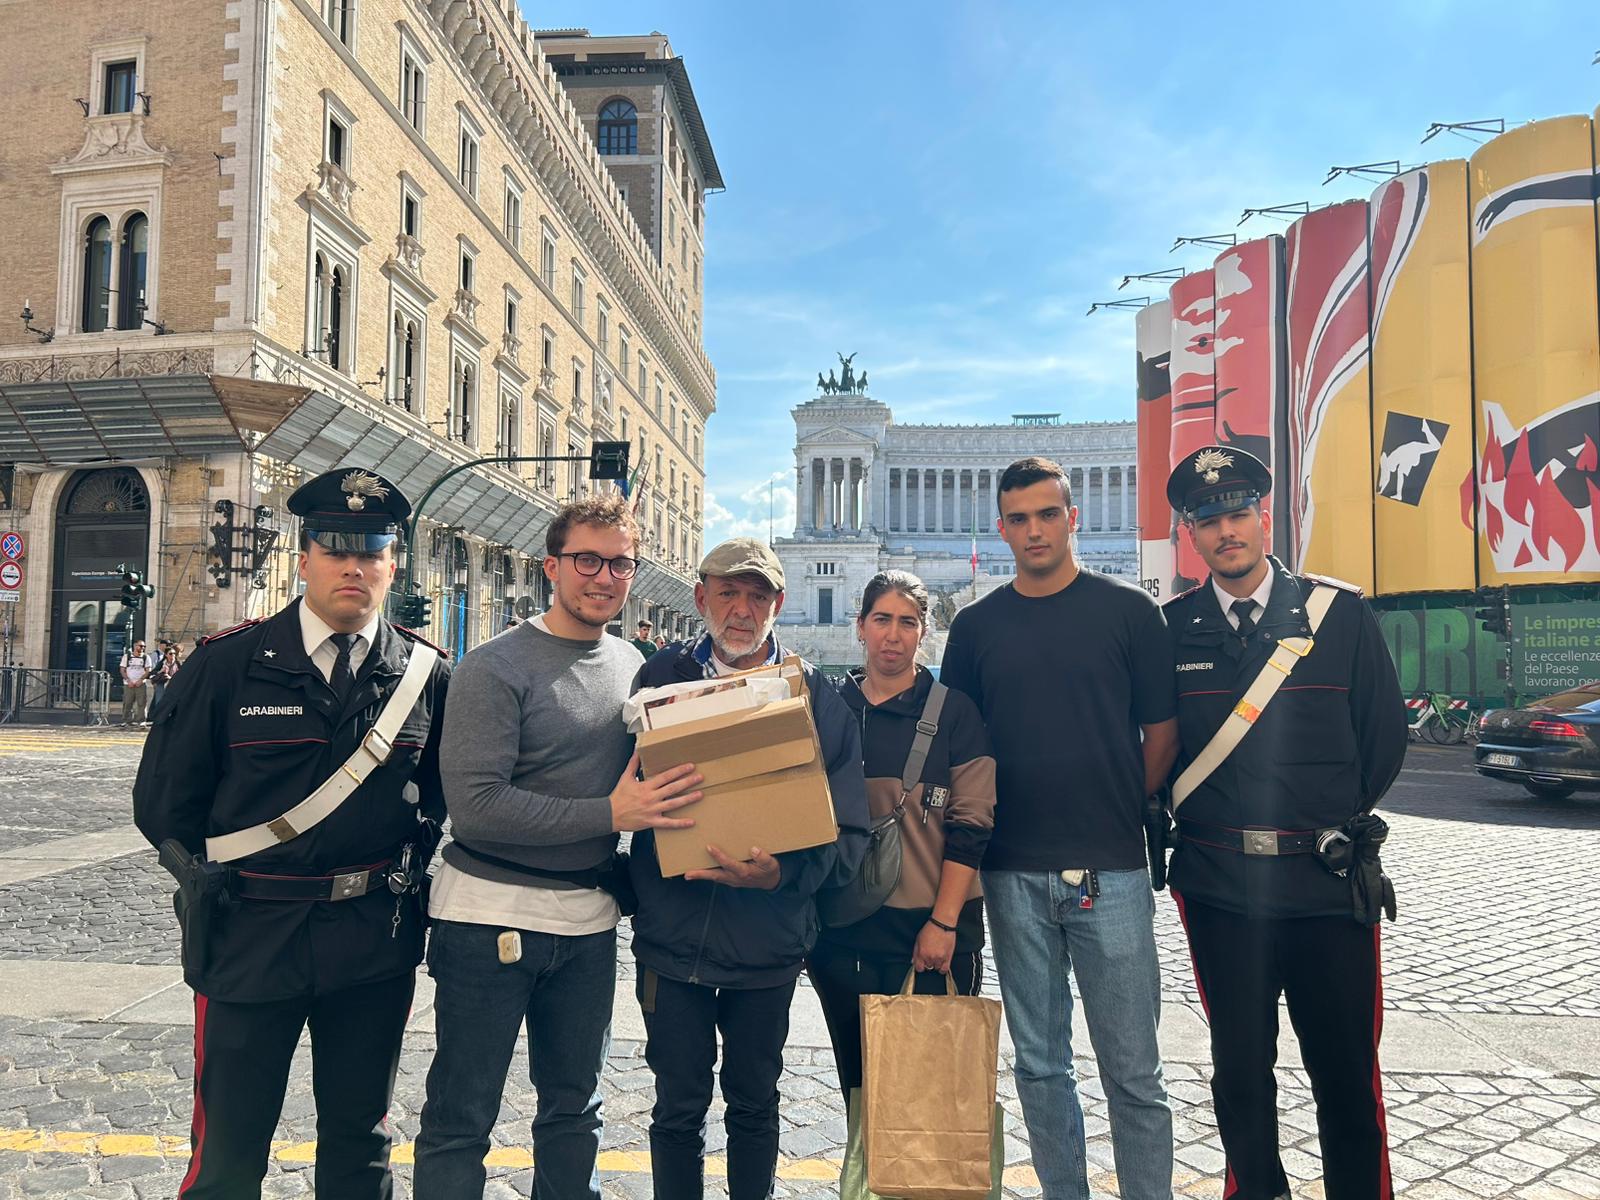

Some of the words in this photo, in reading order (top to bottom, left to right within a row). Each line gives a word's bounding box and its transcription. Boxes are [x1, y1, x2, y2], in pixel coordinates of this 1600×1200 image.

[1525, 616, 1543, 630] Le
[1525, 633, 1590, 647] italiane
[1525, 651, 1538, 661] Le
[1541, 650, 1600, 661] eccellenze
[1525, 663, 1542, 674] del
[1546, 663, 1579, 674] Paese
[1525, 675, 1575, 687] lavorano
[240, 706, 303, 716] CARABINIERI
